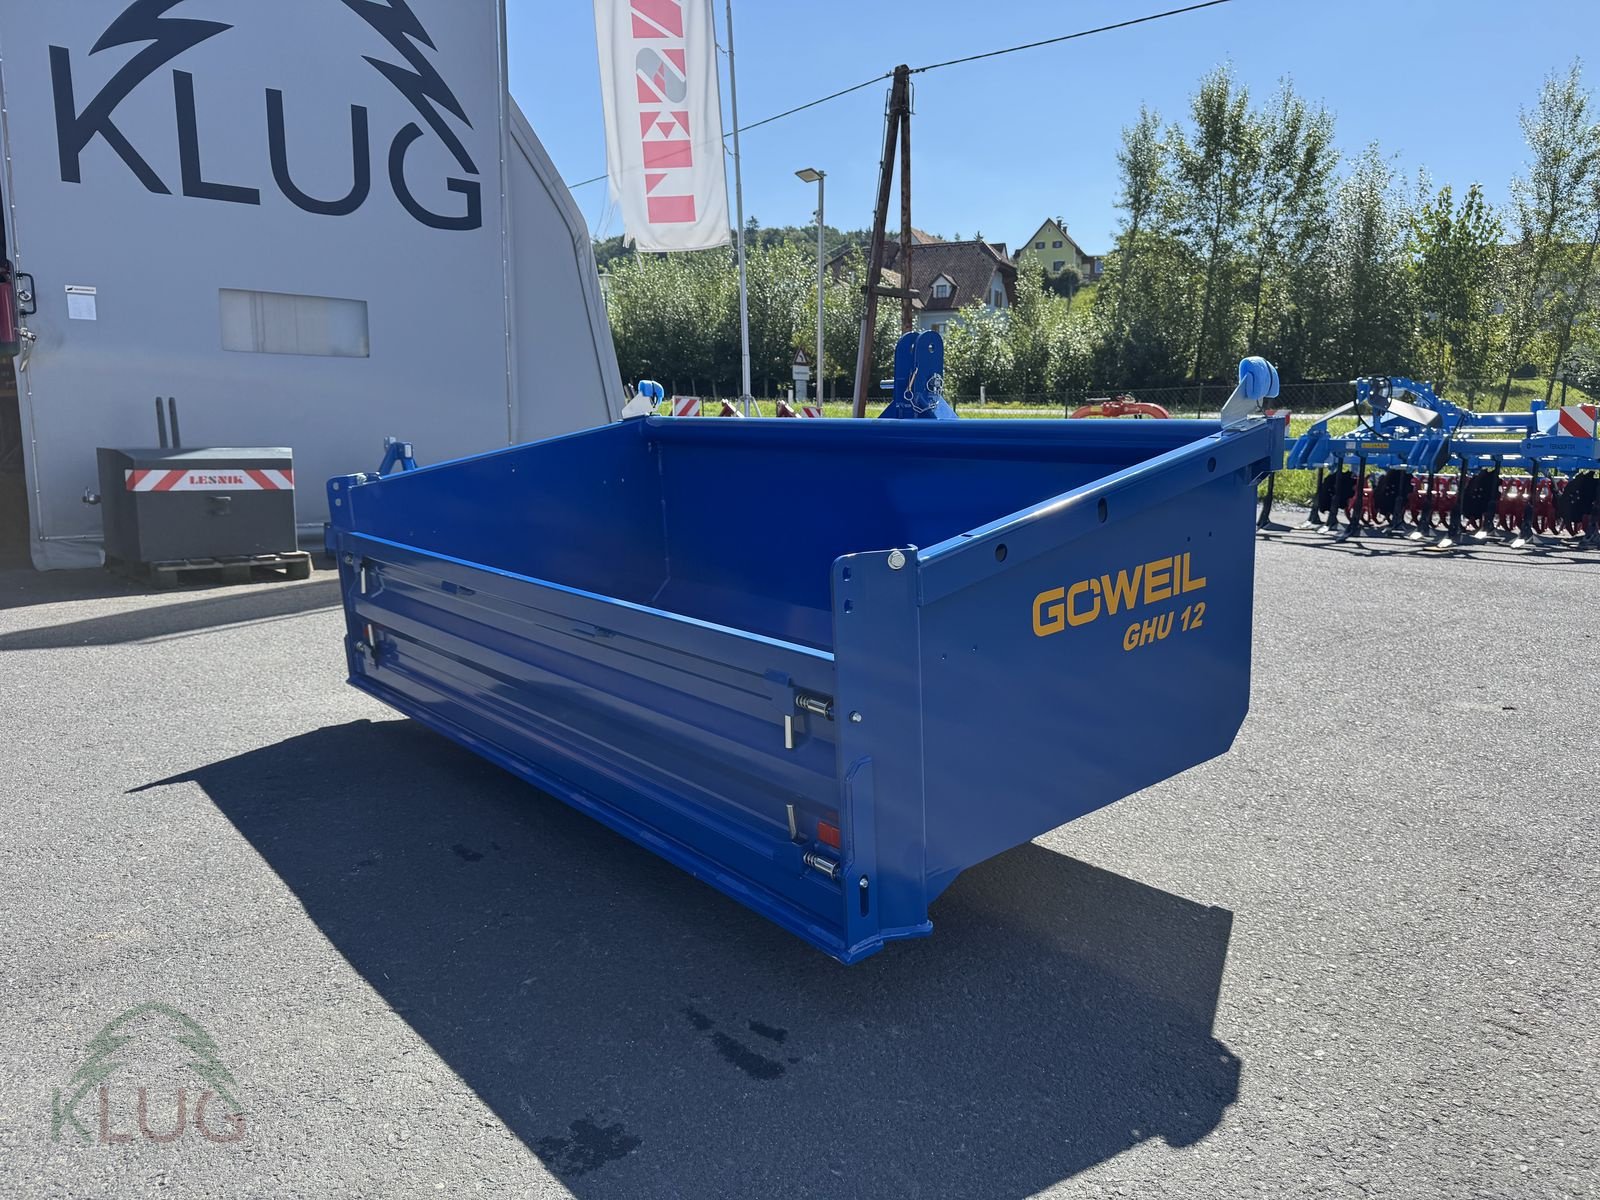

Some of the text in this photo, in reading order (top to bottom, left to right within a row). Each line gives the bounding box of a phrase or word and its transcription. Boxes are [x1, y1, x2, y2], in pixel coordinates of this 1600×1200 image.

[48, 44, 482, 231] KLUG
[189, 475, 244, 485] LESNIK
[1122, 602, 1206, 651] GHU 12
